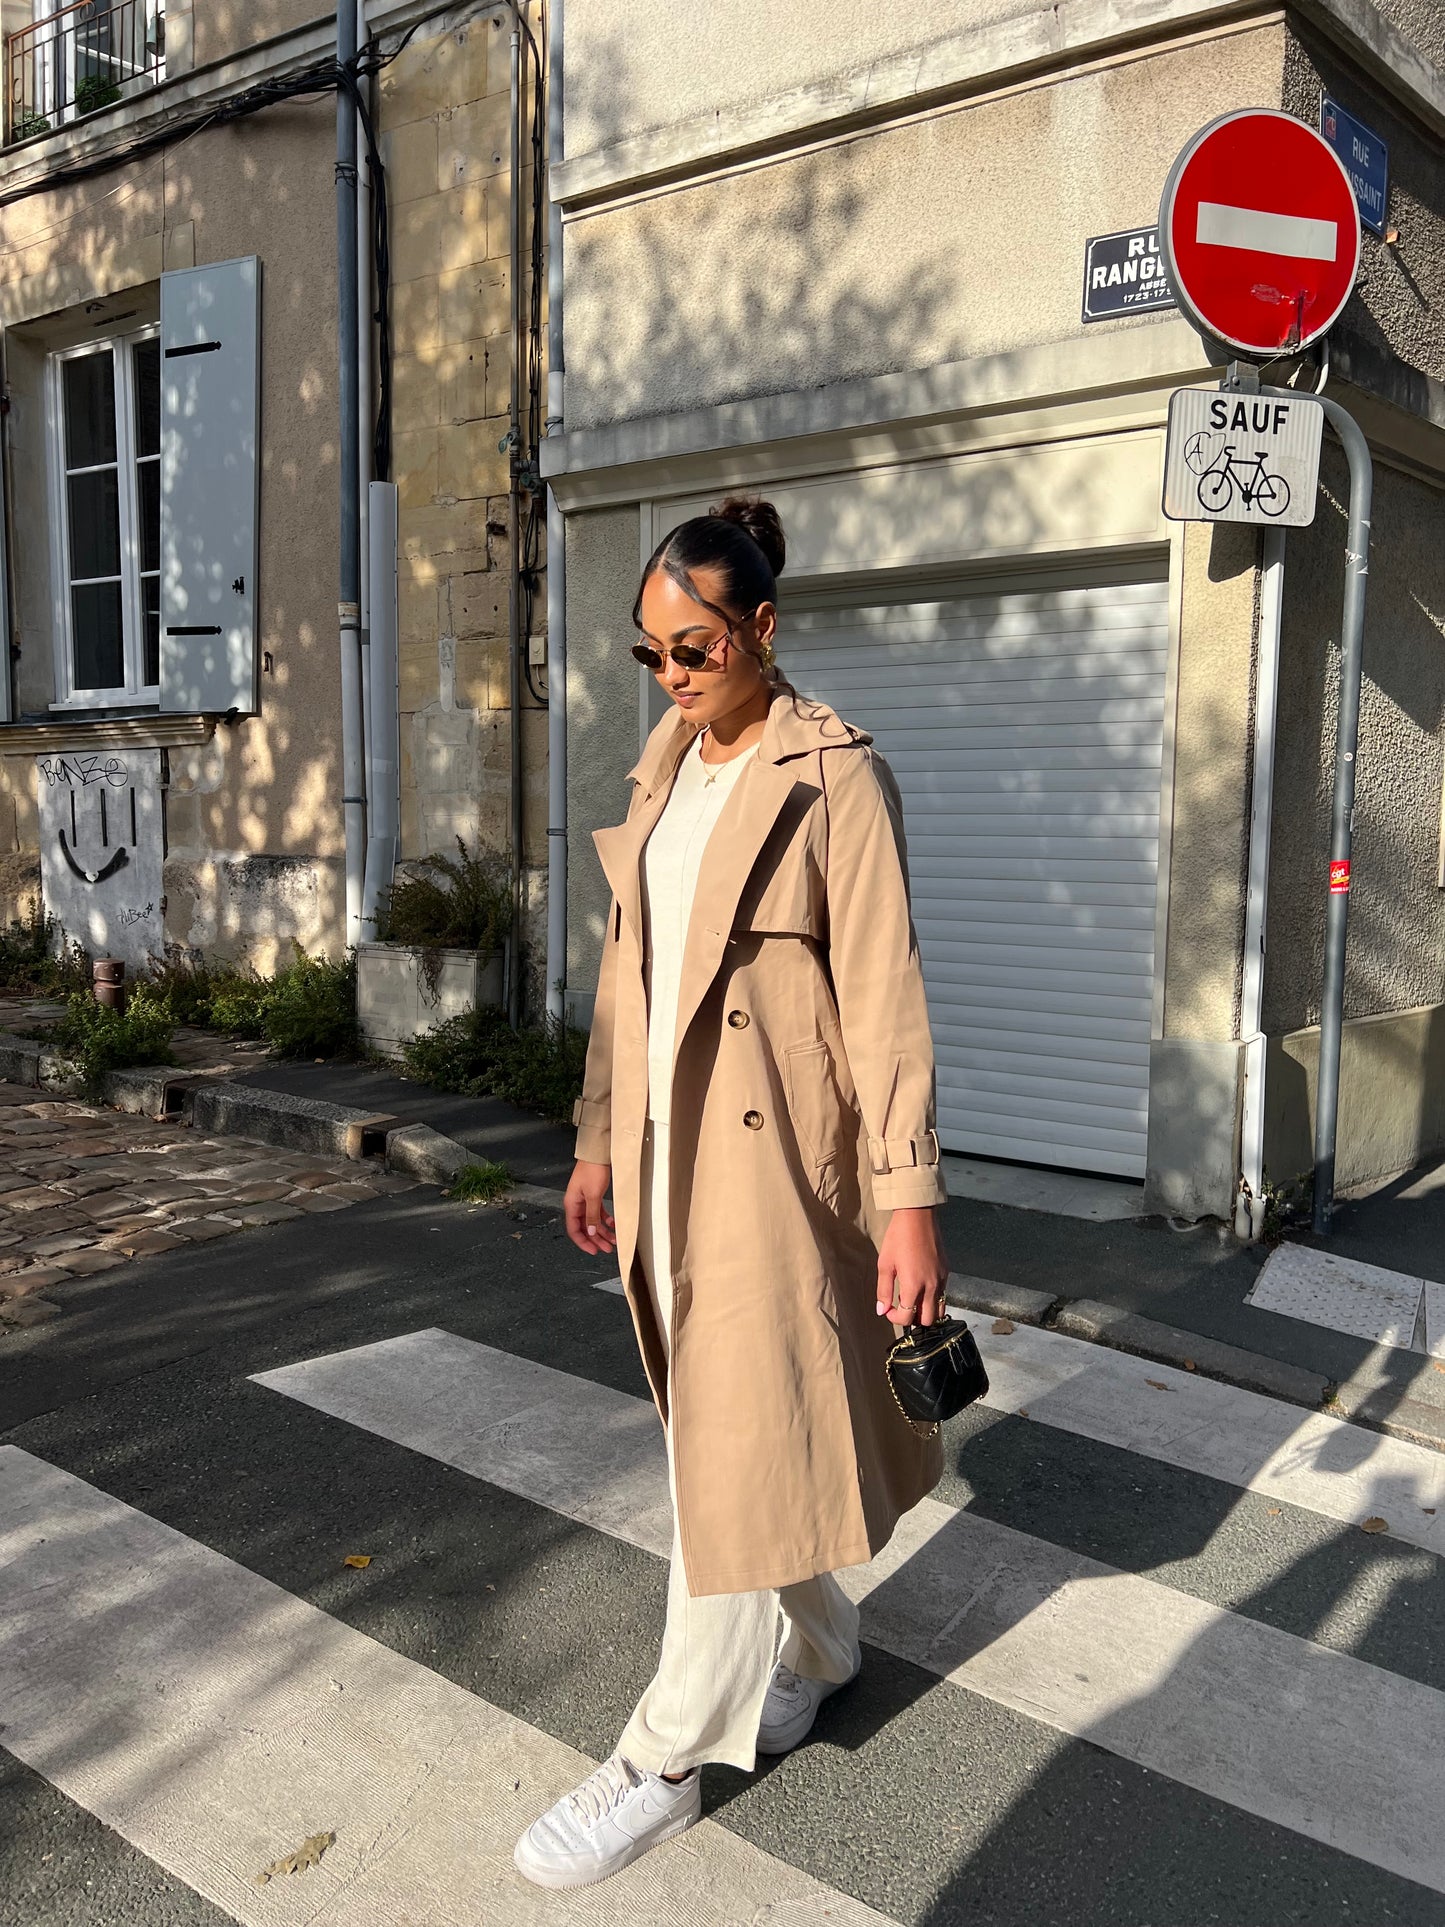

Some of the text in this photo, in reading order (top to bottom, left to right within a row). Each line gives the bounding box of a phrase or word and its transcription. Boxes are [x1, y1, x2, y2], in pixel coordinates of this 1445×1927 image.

[1352, 136, 1369, 168] RUE
[1128, 234, 1160, 258] RU
[1209, 399, 1290, 435] SAUF
